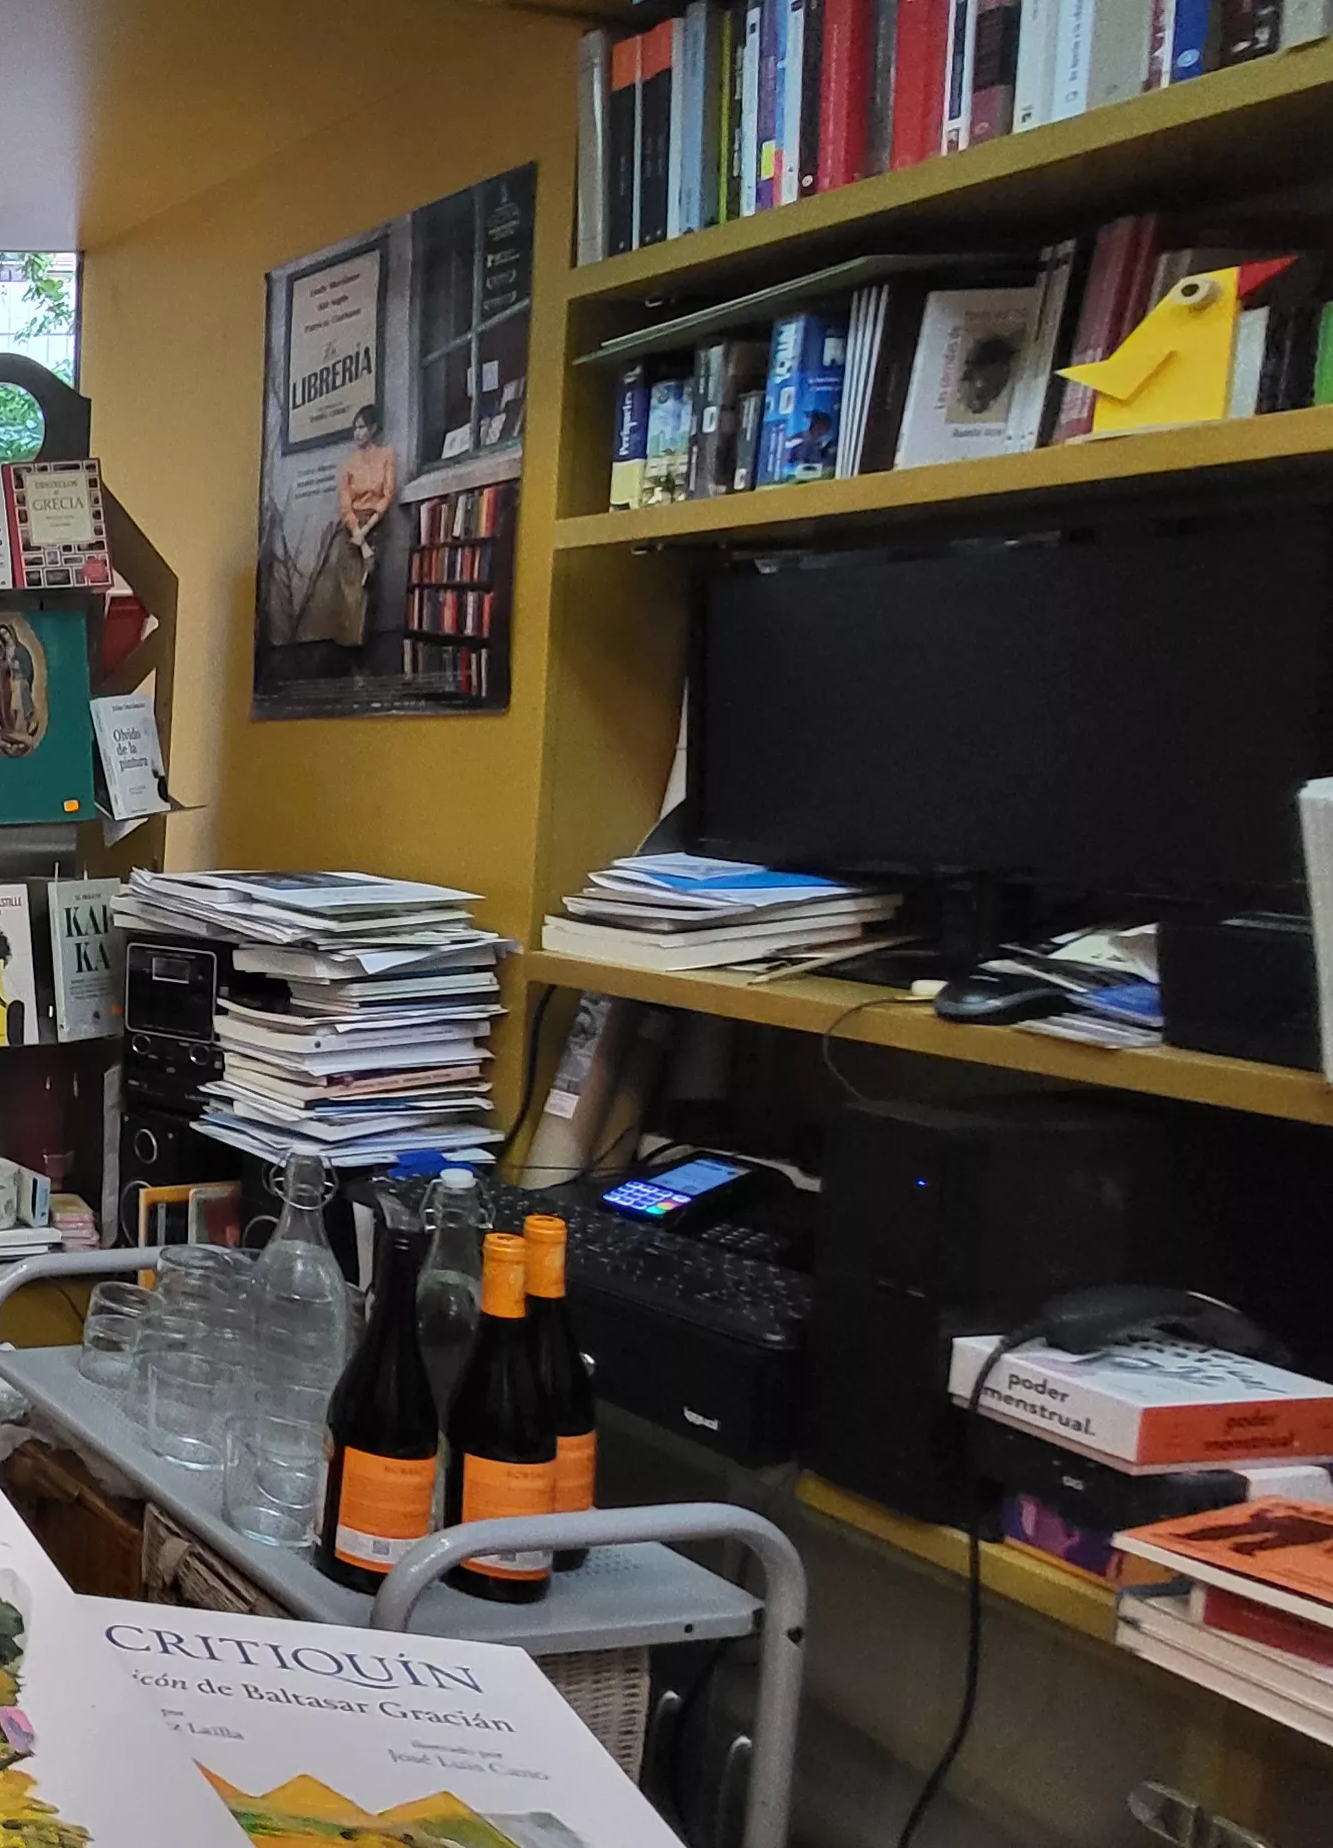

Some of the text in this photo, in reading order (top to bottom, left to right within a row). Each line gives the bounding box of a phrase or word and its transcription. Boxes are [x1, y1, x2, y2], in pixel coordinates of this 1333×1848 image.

[292, 342, 372, 411] LIBRERÍA
[32, 498, 85, 512] GRECIA
[113, 727, 141, 742] Olvido
[117, 742, 137, 755] de la
[74, 940, 111, 973] KA
[1008, 1371, 1070, 1403] poder
[105, 1623, 484, 1694] CRITIQUÍN
[197, 1678, 234, 1697] de
[241, 1683, 369, 1715] Baltasar
[378, 1700, 517, 1734] Gracián
[387, 1748, 432, 1766] José
